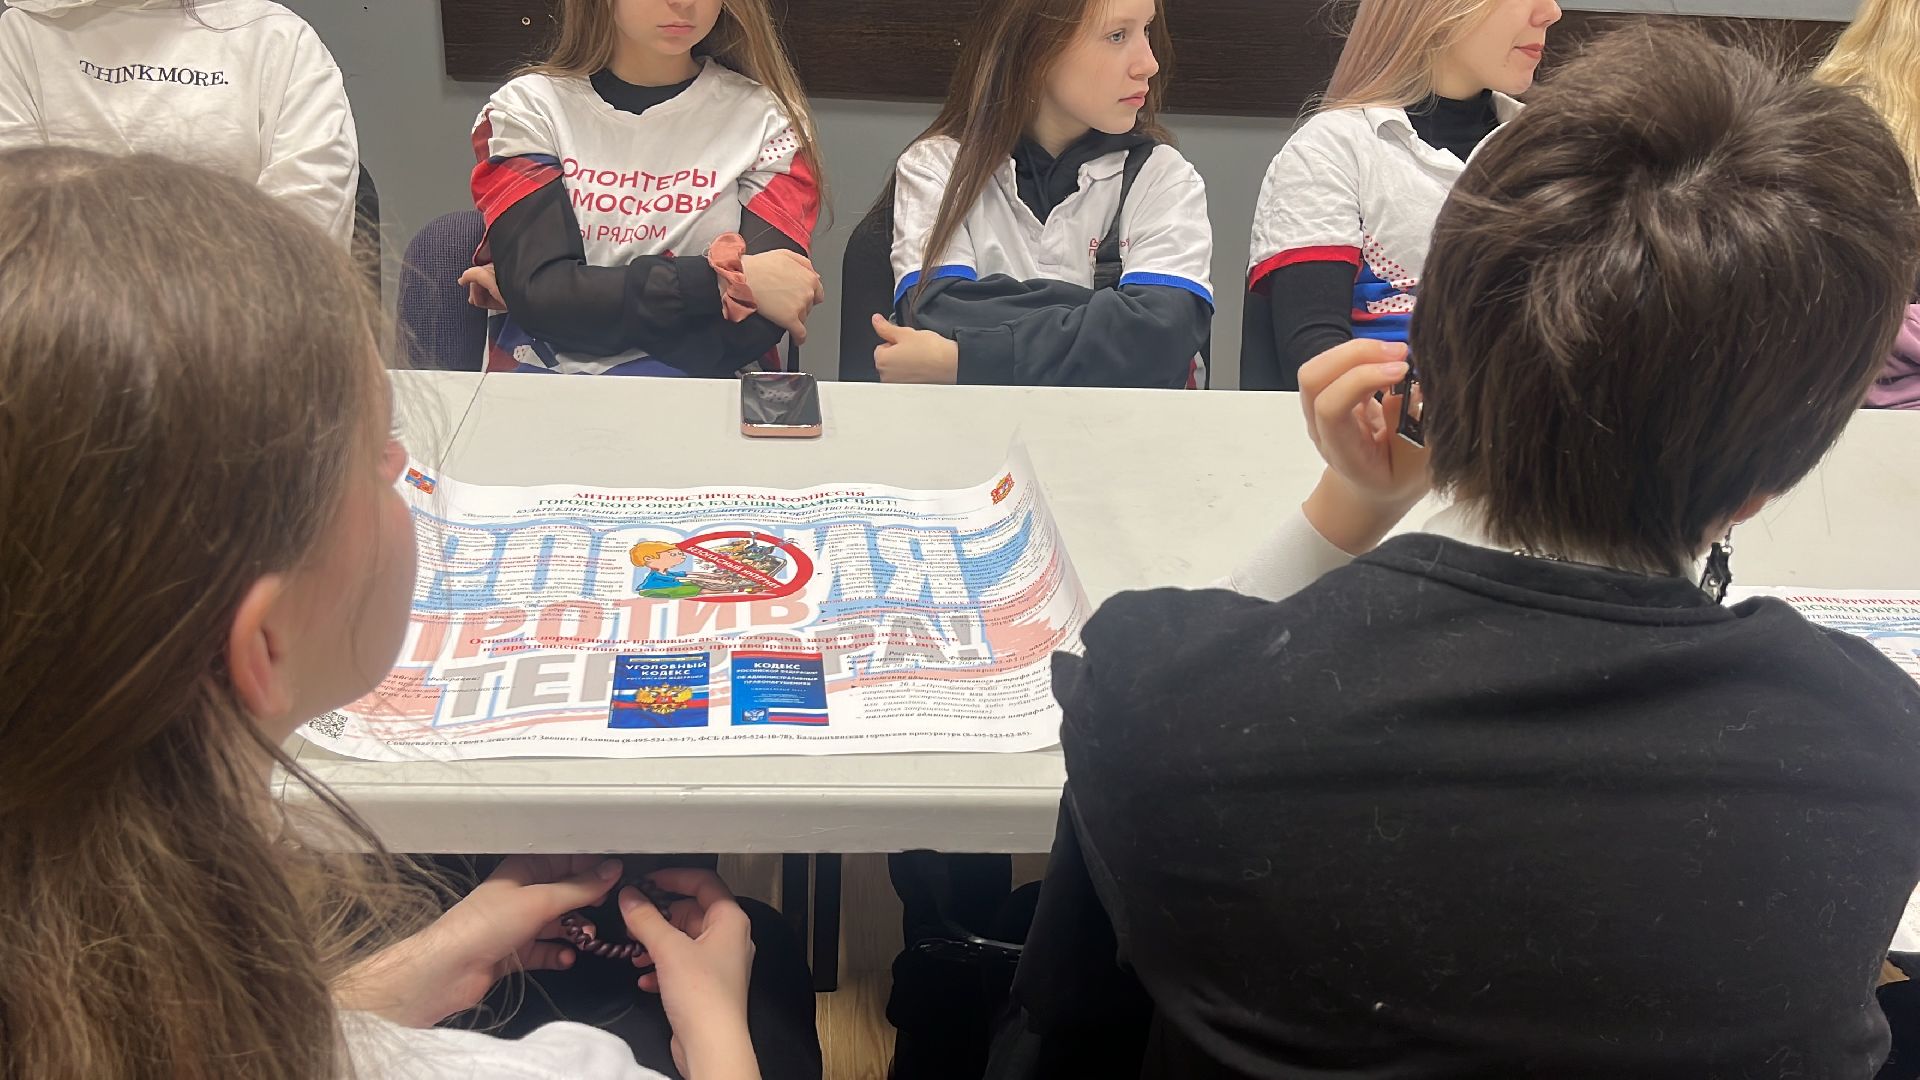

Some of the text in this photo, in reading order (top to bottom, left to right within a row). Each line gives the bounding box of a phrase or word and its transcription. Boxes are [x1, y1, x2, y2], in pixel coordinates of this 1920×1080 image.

[563, 157, 717, 192] ОЛОНТЕРЫ
[567, 189, 722, 216] МОСКОВЬ
[597, 224, 667, 245] РЯДОМ
[573, 491, 865, 502] АНТИТЕРРОРИСТИЧЕСКАЯ КОМИССИЯ
[539, 497, 897, 510] ГОРОДСКОГО ОКРУГА БАЛАШИХА РАЗЪЯСНЯЕТ!
[470, 636, 537, 645] Основные
[541, 636, 629, 645] нормативные
[632, 637, 695, 646] правовые
[738, 634, 801, 643] которыми
[806, 632, 875, 644] закреплена
[877, 632, 959, 642] деятельность
[502, 644, 620, 653] противодействию
[623, 645, 705, 653] незаконному
[709, 642, 822, 652] противоправному
[625, 662, 707, 670] УГОЛОВНЫЙ
[754, 662, 801, 670] КОДЕКС
